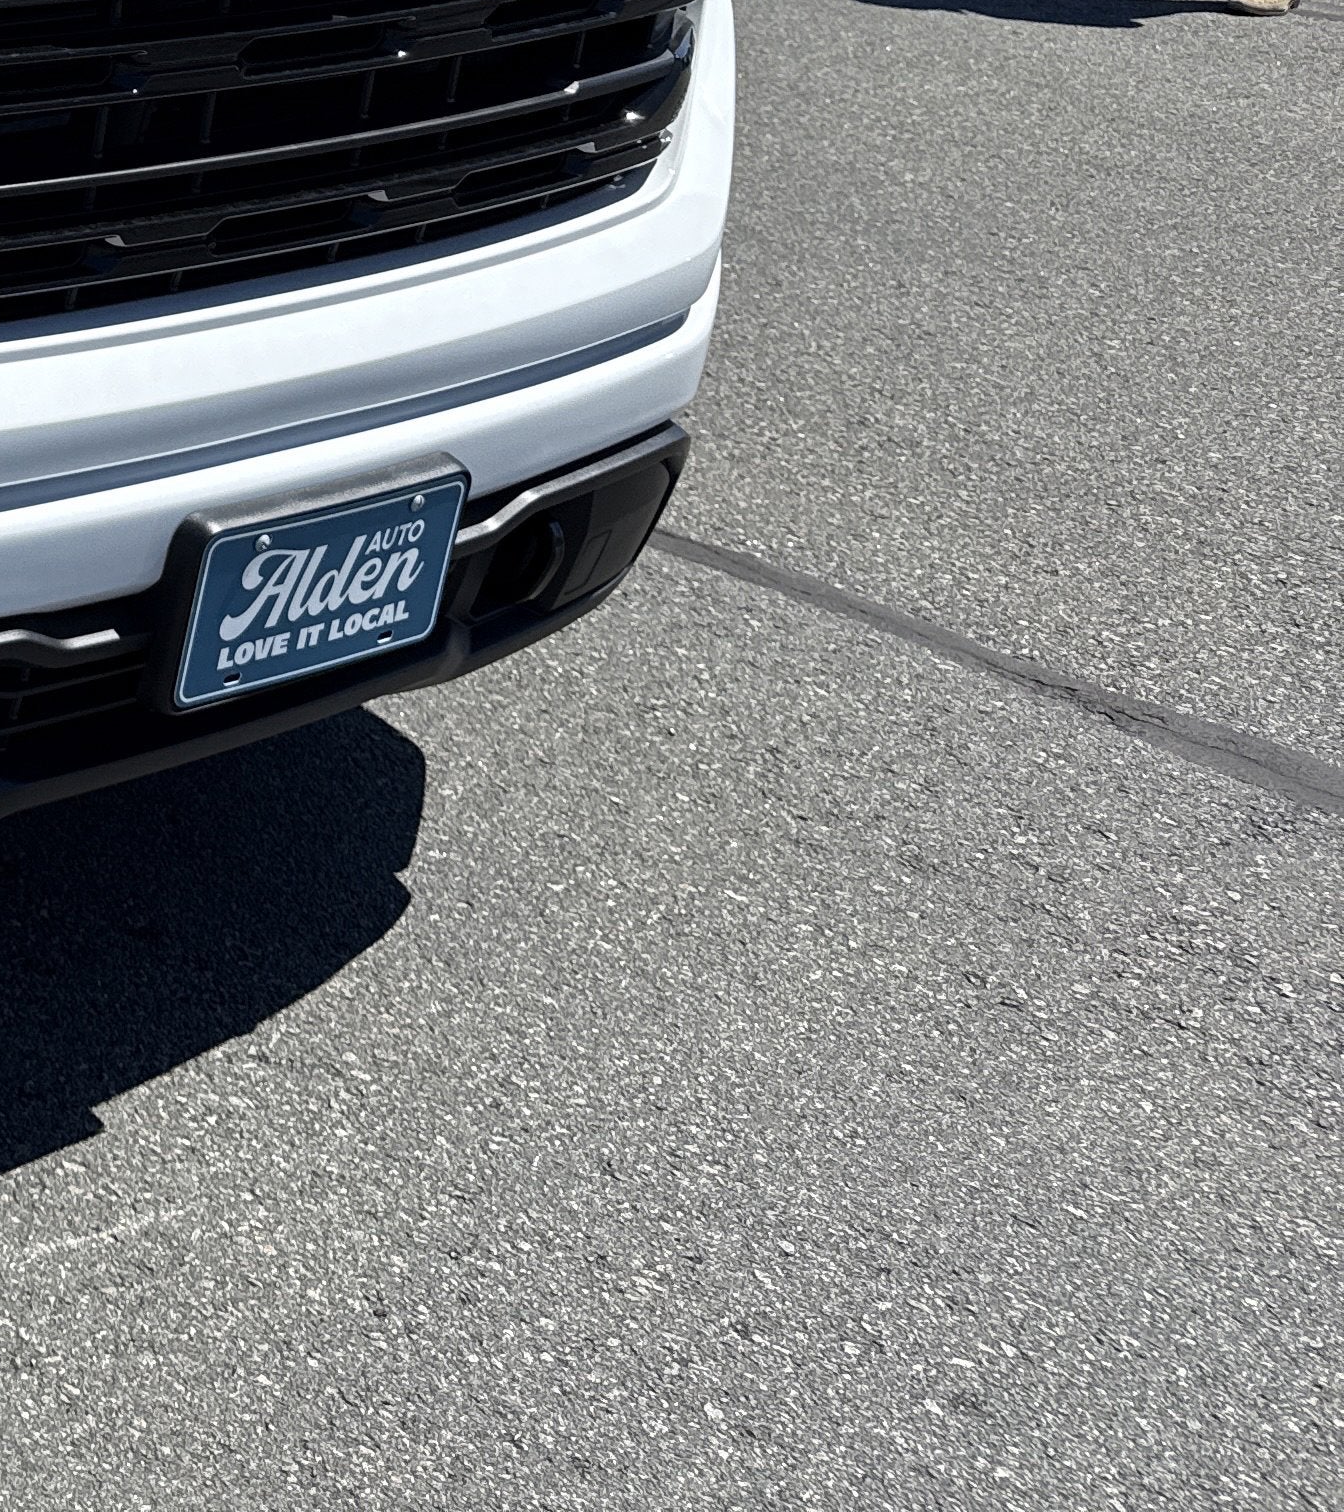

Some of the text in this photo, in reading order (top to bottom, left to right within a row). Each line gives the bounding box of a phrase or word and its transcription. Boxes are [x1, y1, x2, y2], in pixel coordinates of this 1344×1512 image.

[364, 519, 425, 555] AUTO
[219, 535, 424, 641] Alden
[216, 600, 410, 670] LOVE IT LOCAL
